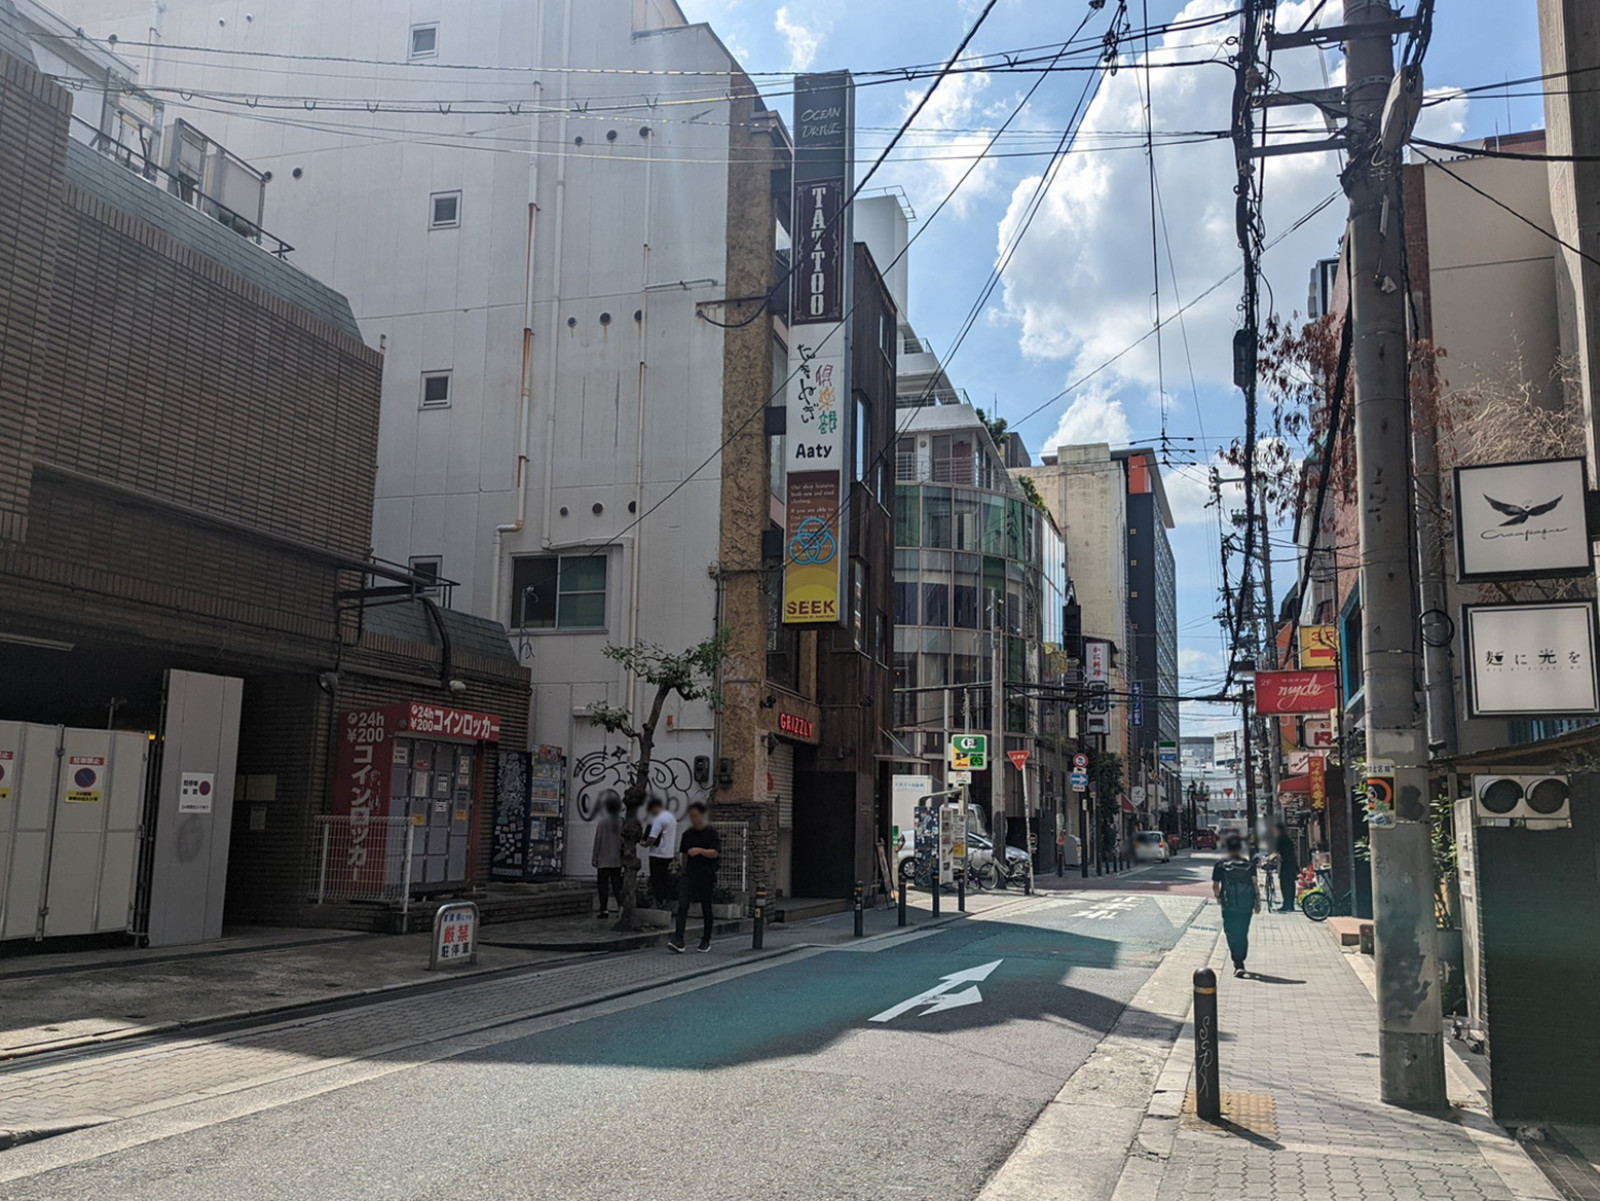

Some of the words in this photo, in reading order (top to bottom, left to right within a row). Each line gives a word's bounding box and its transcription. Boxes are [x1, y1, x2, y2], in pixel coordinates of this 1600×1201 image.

[800, 107, 842, 122] OCEAN
[801, 122, 841, 138] DRIVE
[810, 186, 828, 316] TATTOO
[795, 442, 833, 459] Aaty
[786, 599, 836, 615] SEEK
[358, 711, 385, 727] 24h
[417, 706, 435, 719] 24h
[410, 717, 434, 732] ¥200
[433, 709, 500, 739] コインロッカー
[779, 712, 814, 738] GRIZZLY
[346, 727, 384, 743] ¥200
[347, 745, 373, 881] コインロッカー
